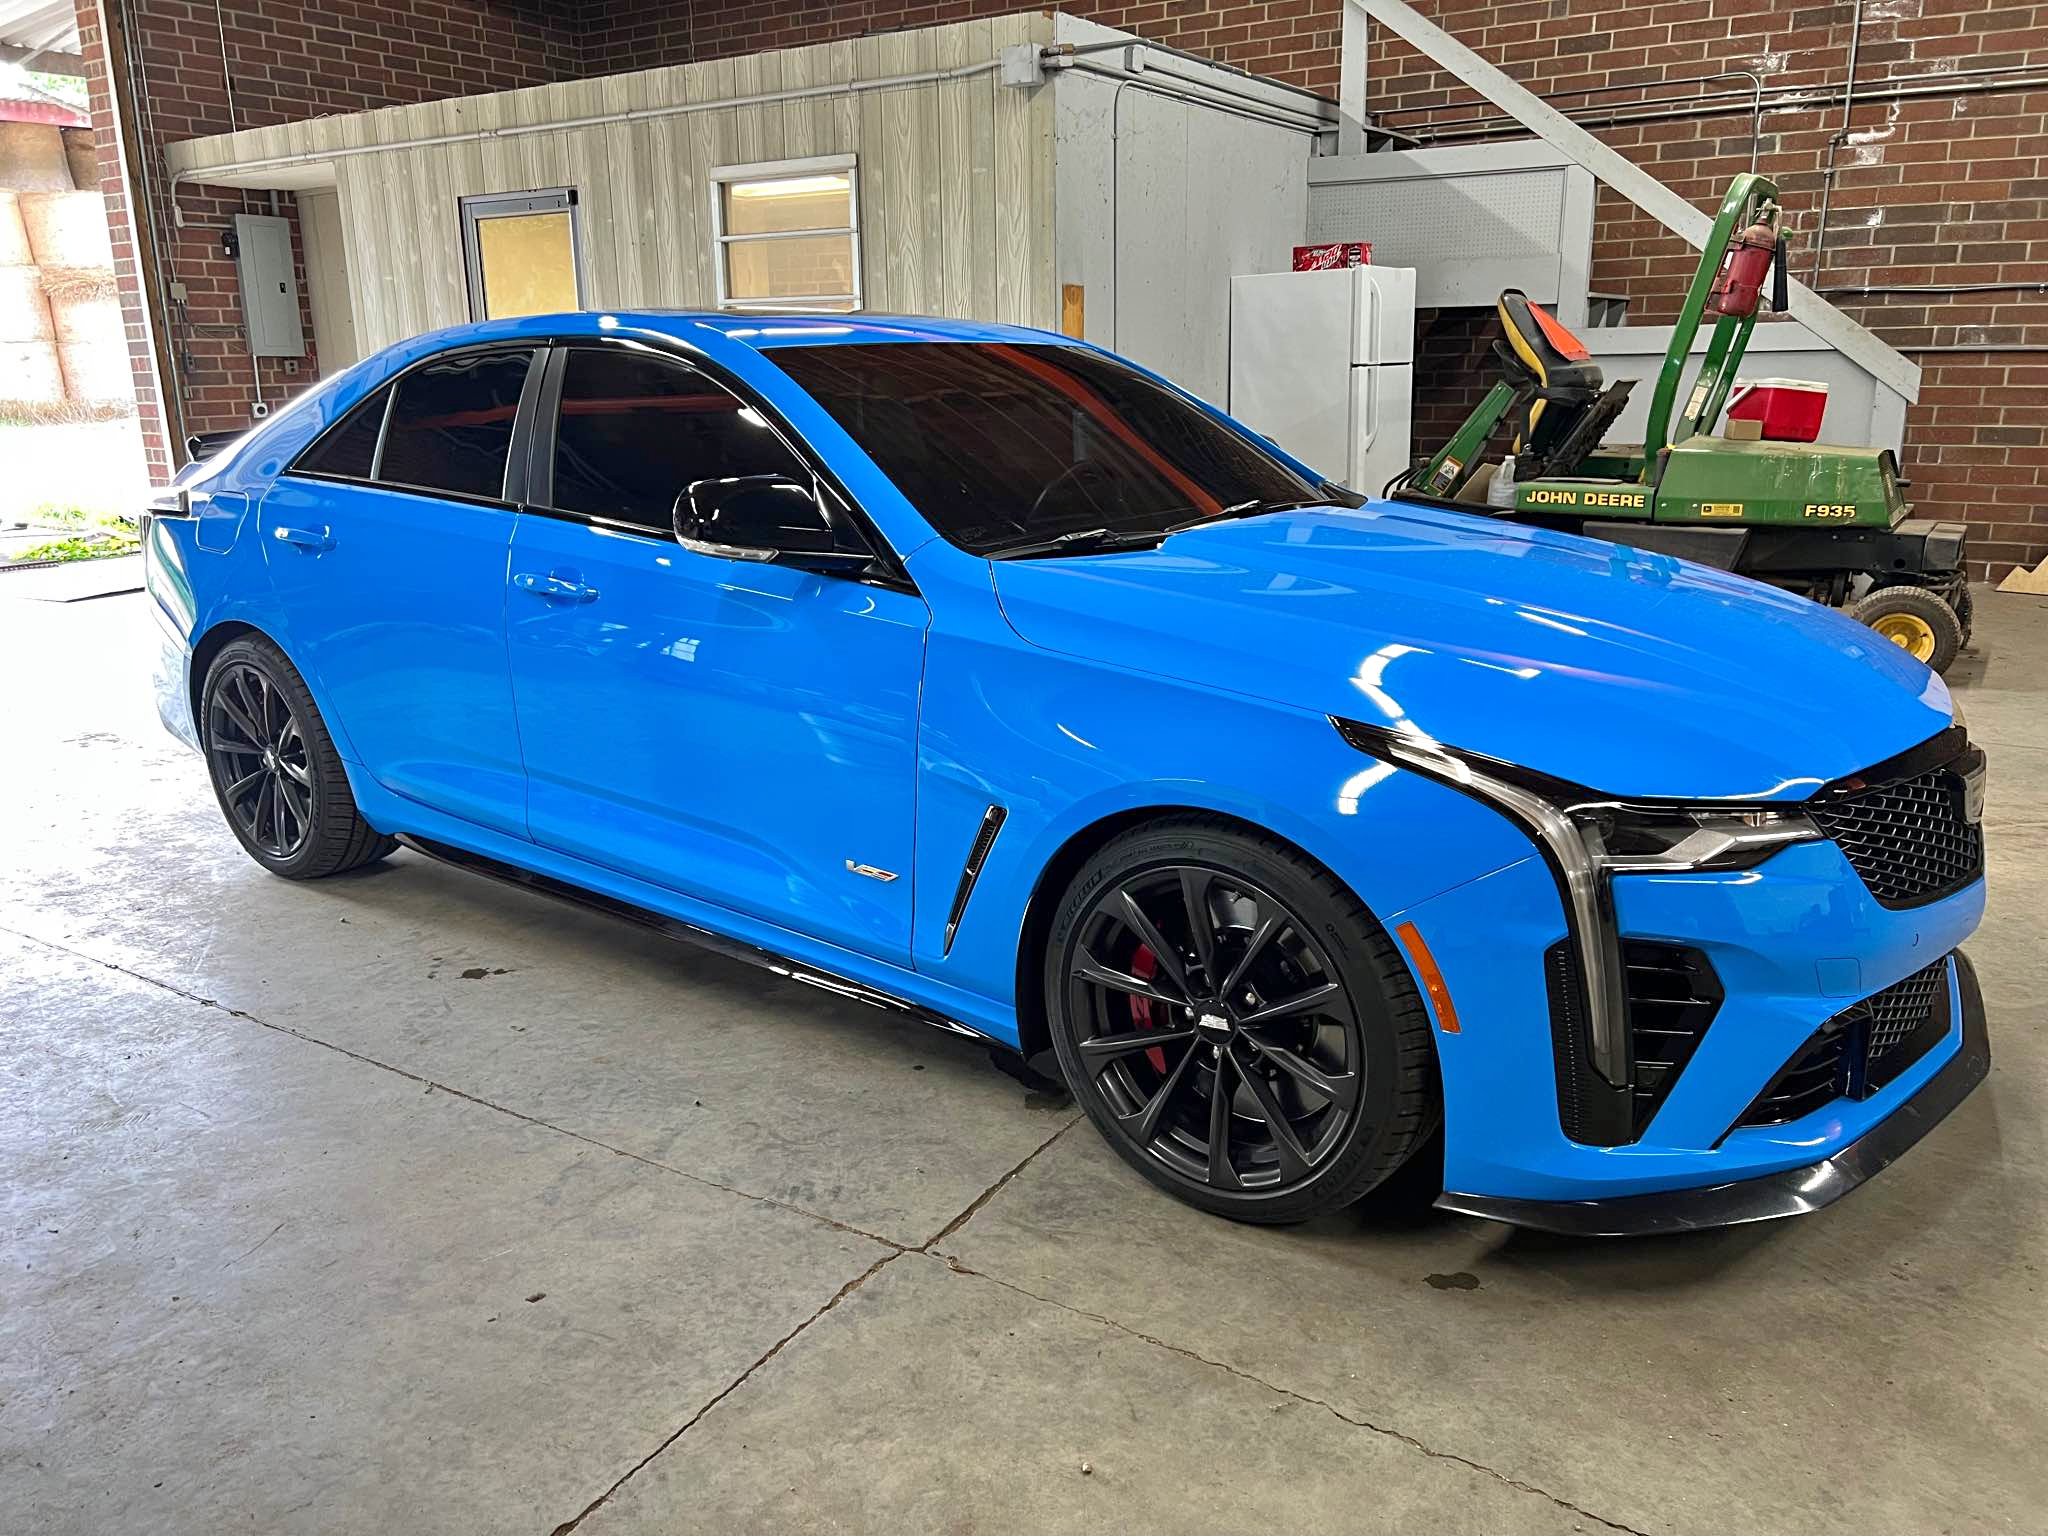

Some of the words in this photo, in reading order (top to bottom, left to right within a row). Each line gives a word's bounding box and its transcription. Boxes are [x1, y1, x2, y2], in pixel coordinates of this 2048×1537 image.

[1526, 490, 1577, 505] JOHN
[1583, 492, 1645, 508] DEERE
[1804, 504, 1856, 518] F935
